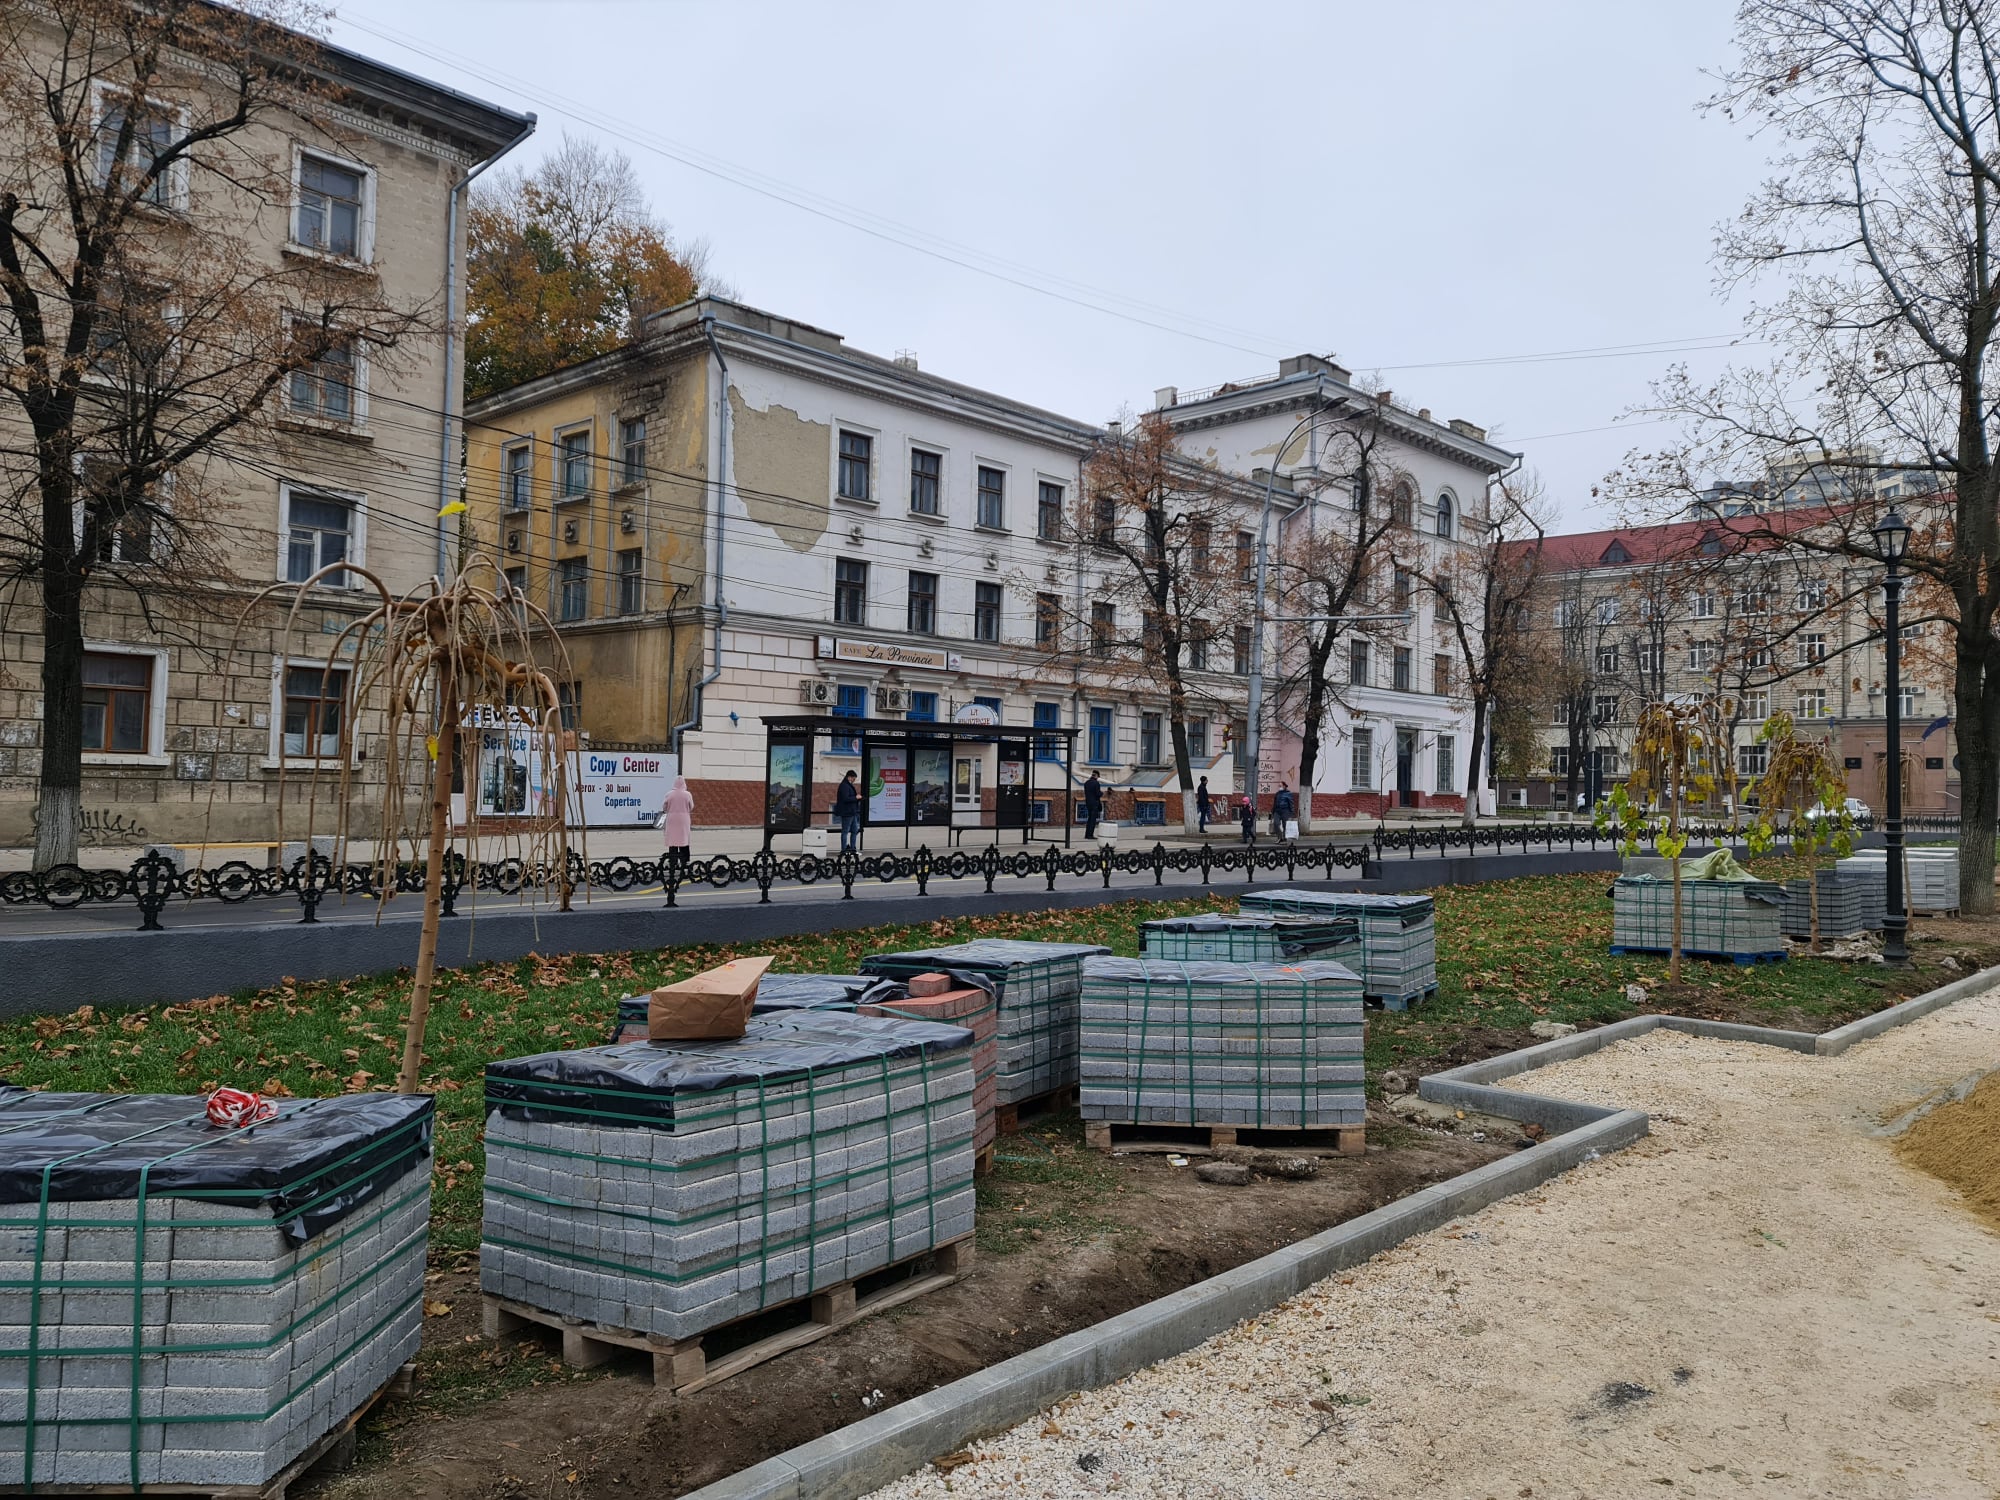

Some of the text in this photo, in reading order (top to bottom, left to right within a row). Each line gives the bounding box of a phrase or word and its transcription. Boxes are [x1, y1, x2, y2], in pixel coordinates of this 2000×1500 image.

[866, 643, 884, 659] La
[887, 645, 933, 665] Provincie
[590, 755, 660, 776] Copy Center
[574, 782, 596, 793] Xerox
[605, 783, 614, 793] 30
[616, 783, 631, 793] bani
[604, 796, 642, 809] Copertare
